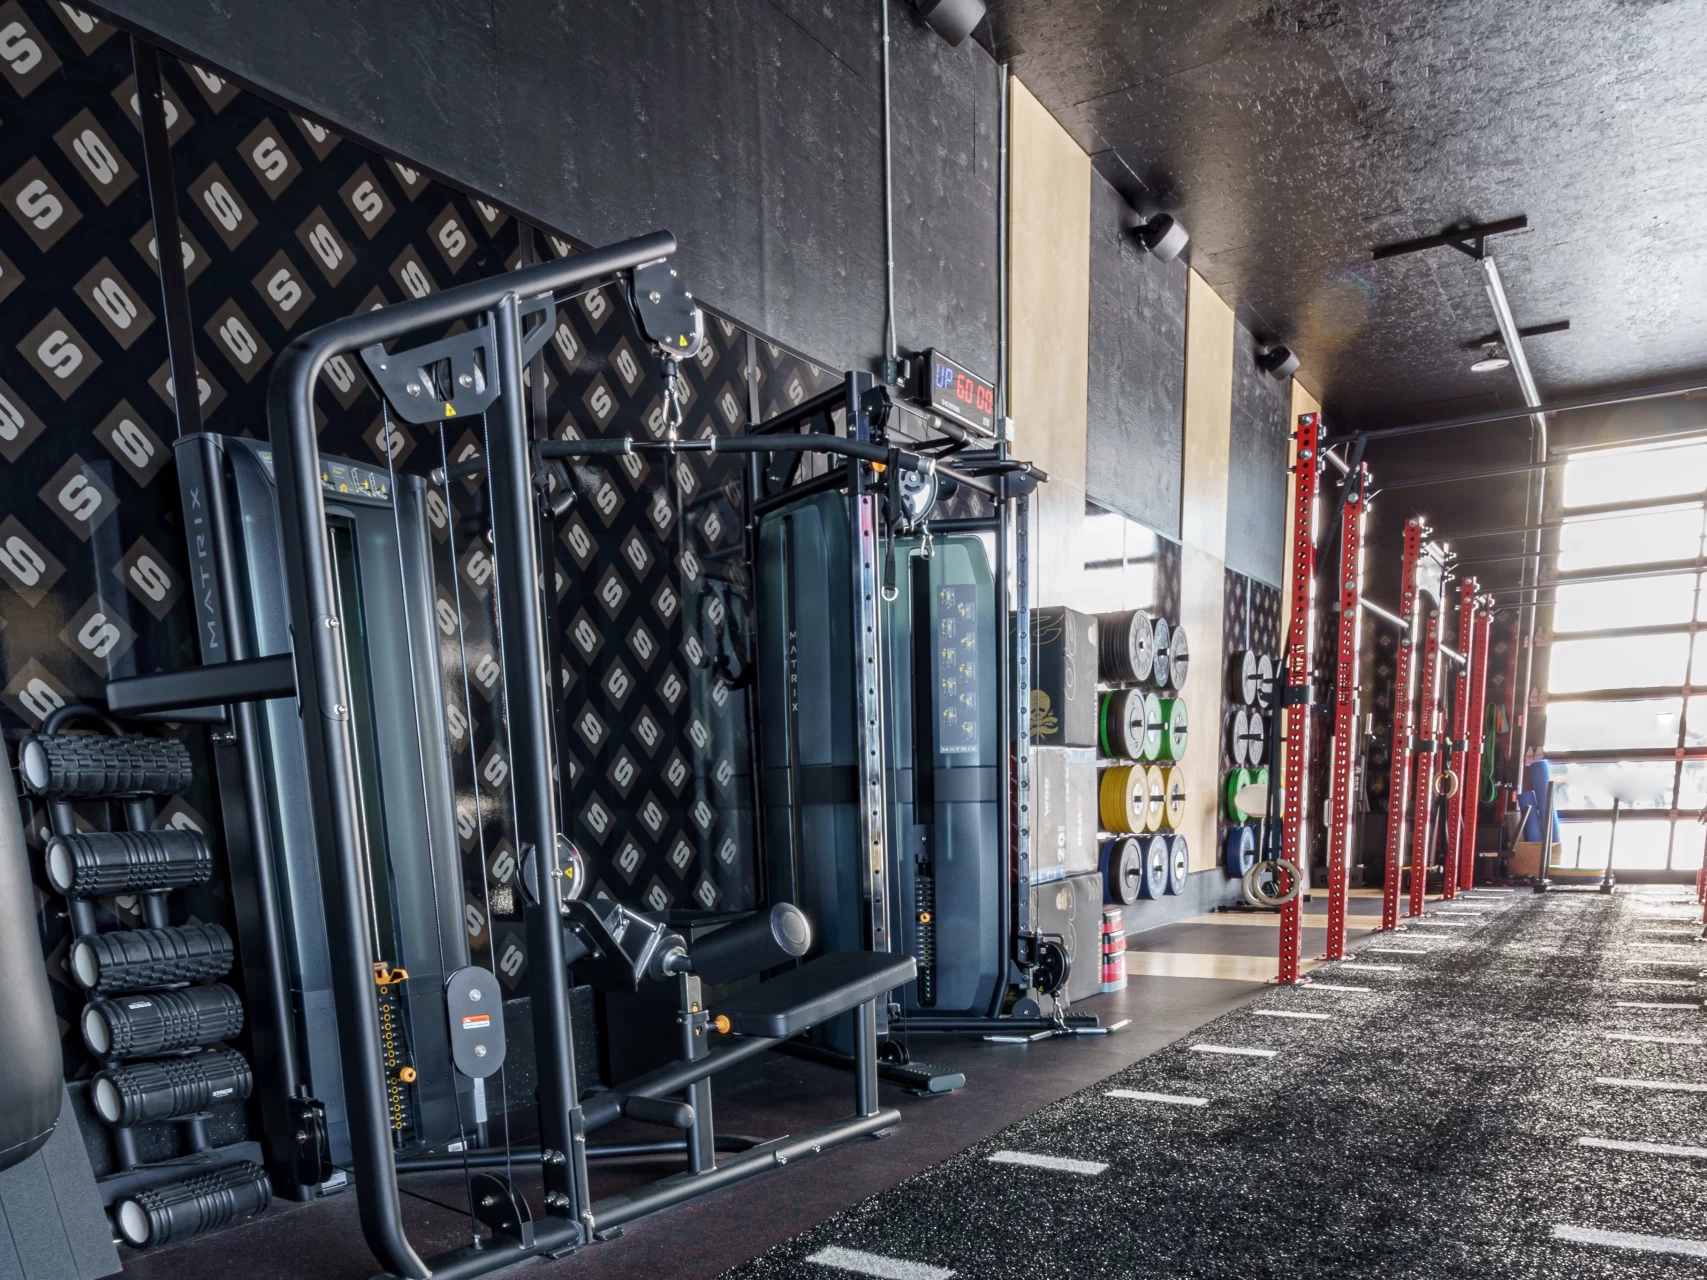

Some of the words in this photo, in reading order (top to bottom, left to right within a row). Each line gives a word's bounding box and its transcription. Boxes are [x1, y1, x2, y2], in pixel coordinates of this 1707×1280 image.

[936, 363, 953, 389] UP
[190, 486, 218, 648] MATRIX
[789, 631, 798, 711] MATRIX
